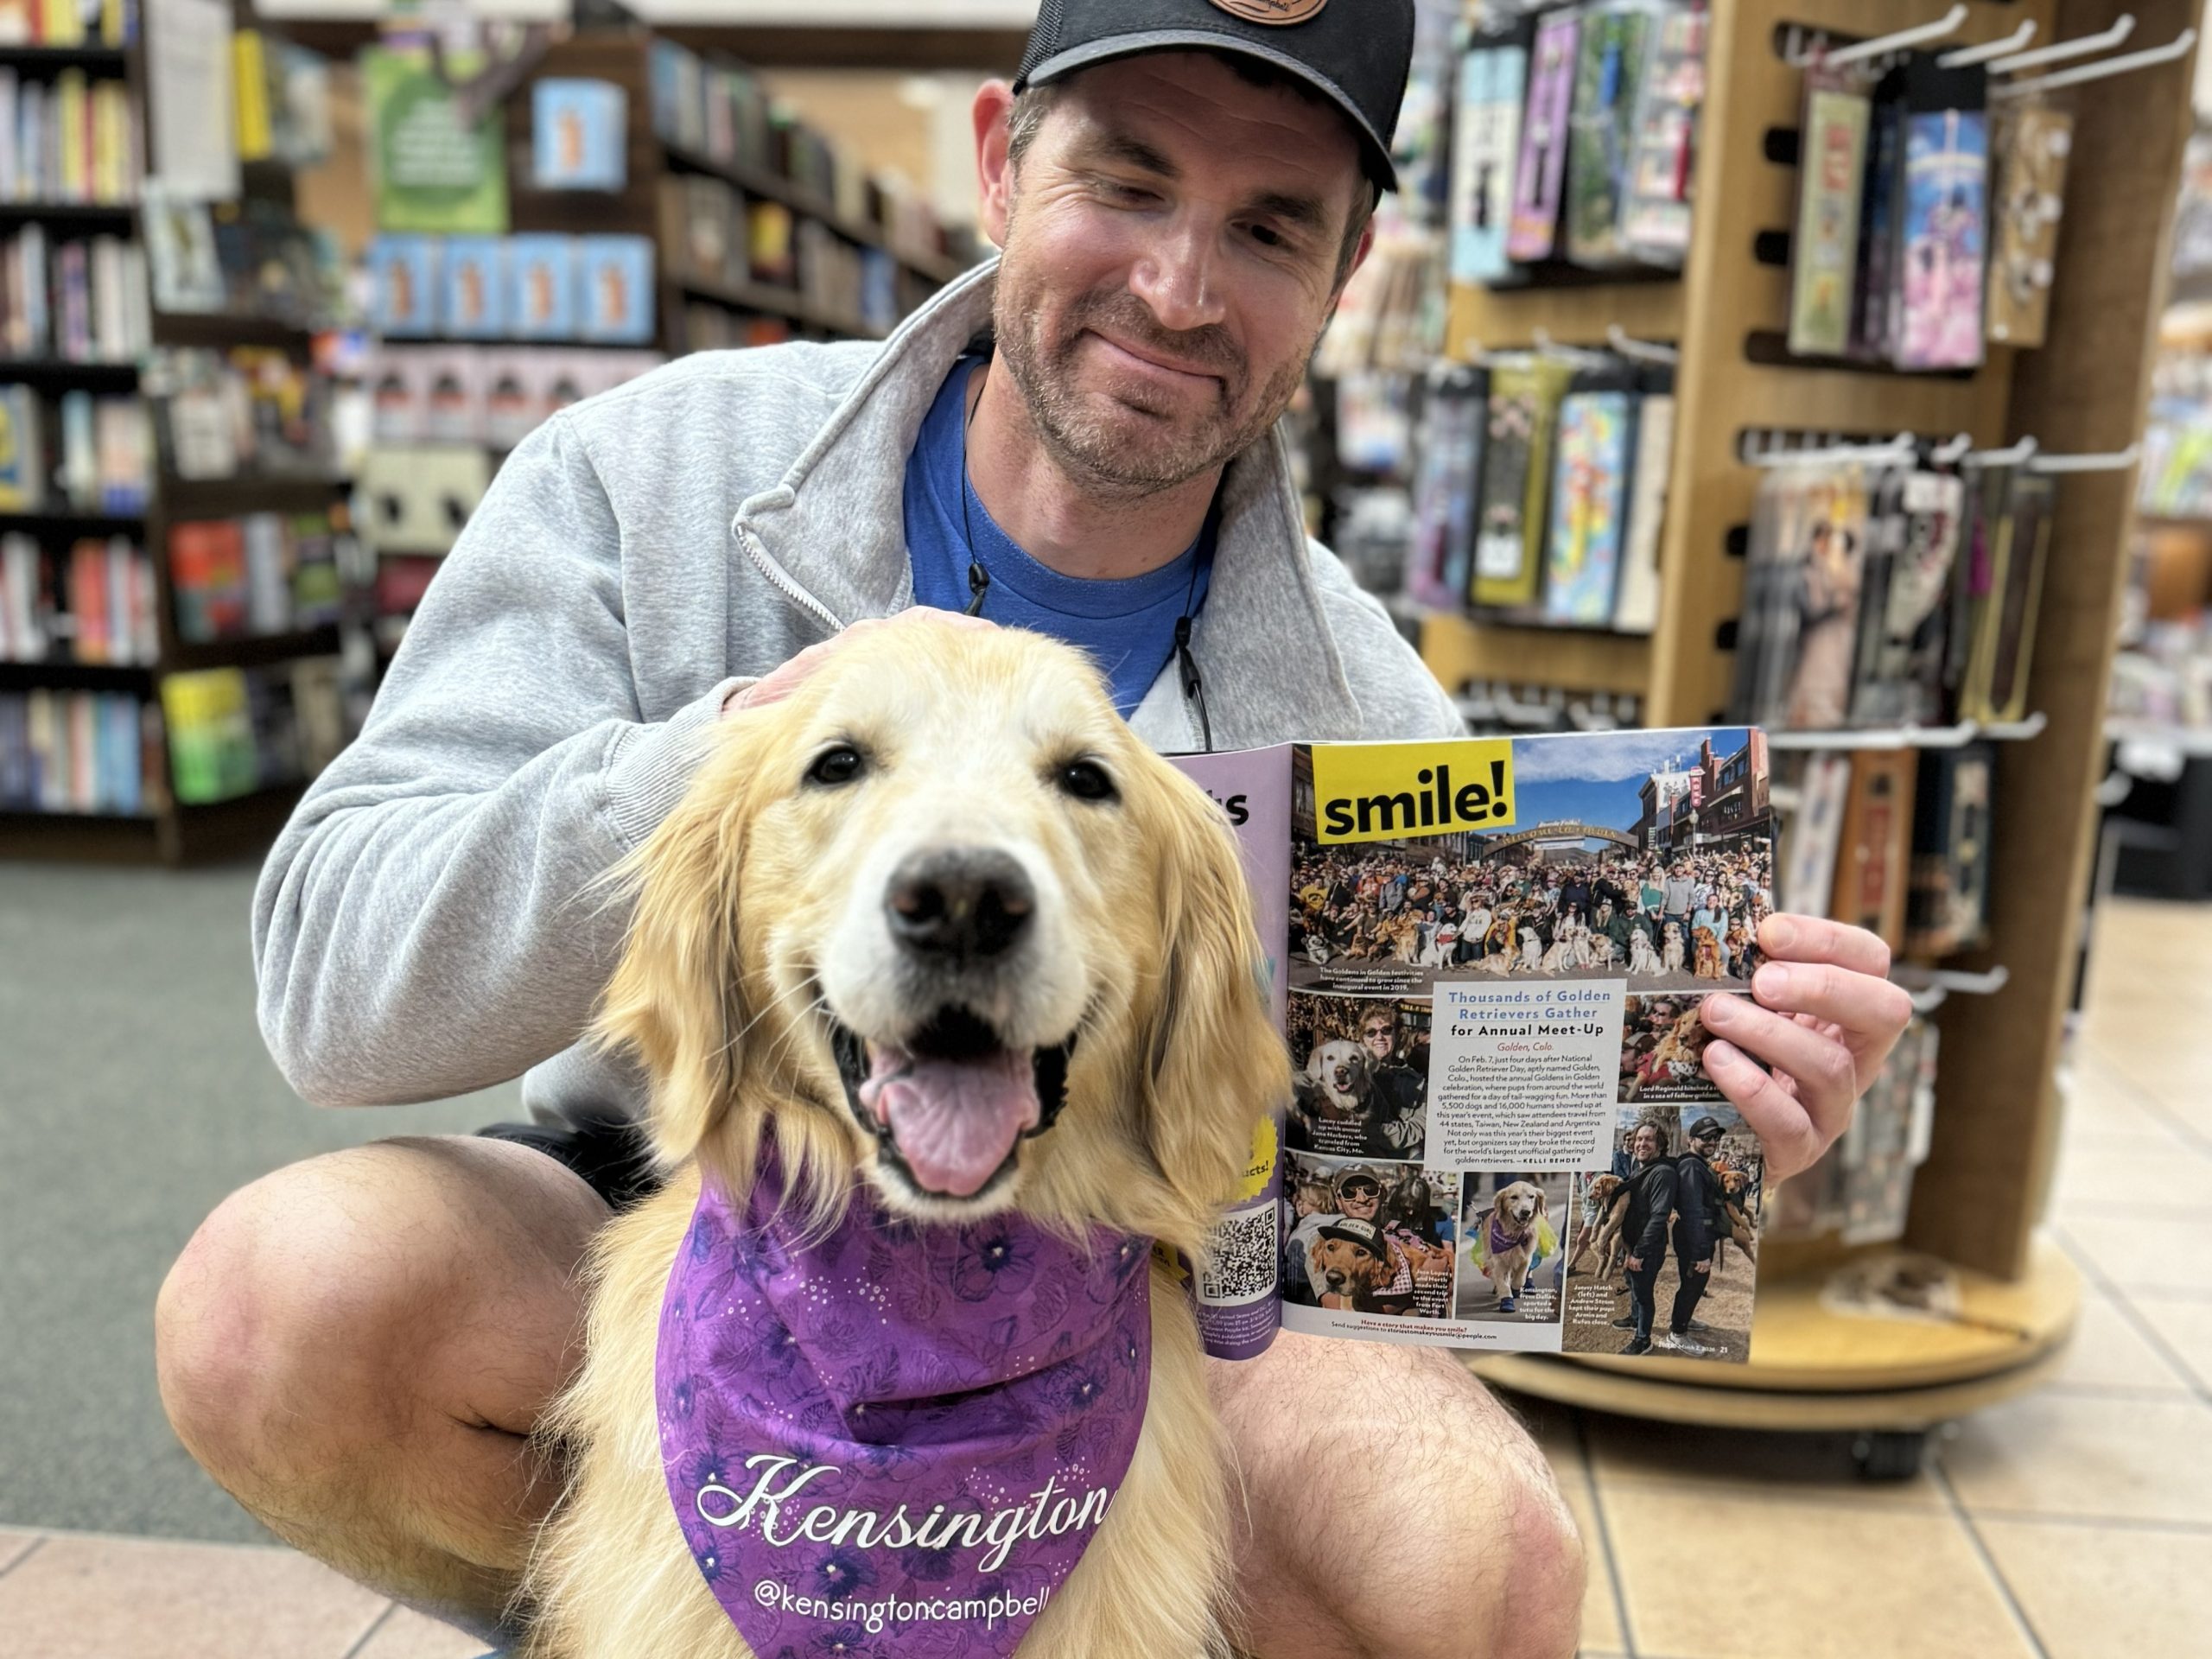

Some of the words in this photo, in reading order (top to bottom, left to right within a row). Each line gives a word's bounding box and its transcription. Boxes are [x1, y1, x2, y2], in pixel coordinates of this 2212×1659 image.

[1324, 760, 1509, 836] smile!
[1449, 992, 1530, 1003] Thousands
[1536, 990, 1551, 1001] of
[1557, 989, 1611, 1001] Golden
[1459, 1008, 1539, 1020] Retrievers
[1546, 1007, 1597, 1019] Gather
[1452, 1025, 1472, 1036] for
[1478, 1025, 1531, 1036] Annual
[1538, 1024, 1604, 1037] Meet-Up
[1497, 1043, 1530, 1052] Golden,
[1533, 1042, 1554, 1051] Colo.
[1494, 1056, 1509, 1065] just
[1525, 1055, 1541, 1065] days
[1528, 1065, 1545, 1074] aptly
[1573, 1064, 1600, 1072] Golden,
[1438, 1093, 1470, 1102] gathered
[1488, 1093, 1501, 1102] day
[1510, 1092, 1554, 1102] tail-wagging
[1465, 1102, 1482, 1110] dogs
[1499, 1102, 1525, 1110] 16,000
[1547, 1129, 1572, 1138] biggest
[1471, 1139, 1508, 1147] organizers
[1522, 1138, 1537, 1148] they
[1493, 1147, 1516, 1156] largest
[1552, 1147, 1586, 1156] gathering
[1455, 1156, 1479, 1166] golden
[696, 1454, 1120, 1573] Kensington
[754, 1580, 1051, 1634] @kensingtoncampbell
